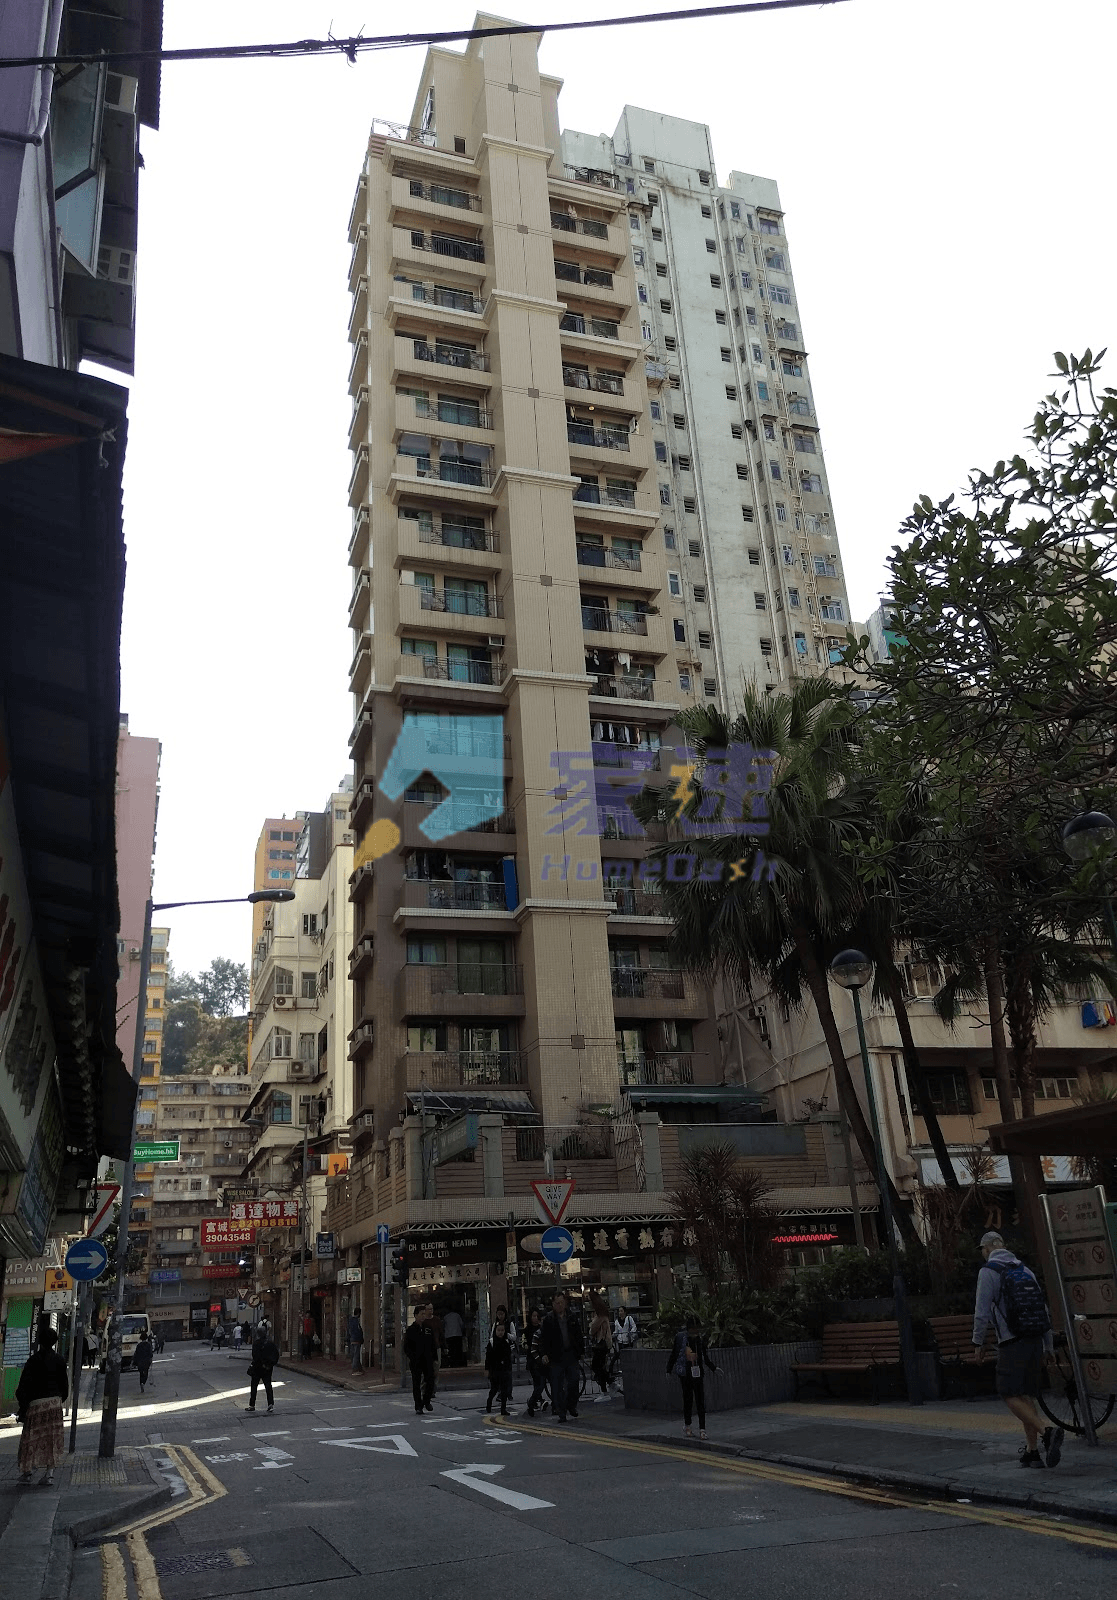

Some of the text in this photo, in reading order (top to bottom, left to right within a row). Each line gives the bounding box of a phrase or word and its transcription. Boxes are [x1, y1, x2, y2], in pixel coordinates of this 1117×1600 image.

[231, 1201, 297, 1220] 通達物業
[205, 1221, 251, 1233] 富城
[205, 1233, 251, 1243] 39043548
[421, 1241, 448, 1250] ELECTRIC
[452, 1239, 478, 1247] HEATING
